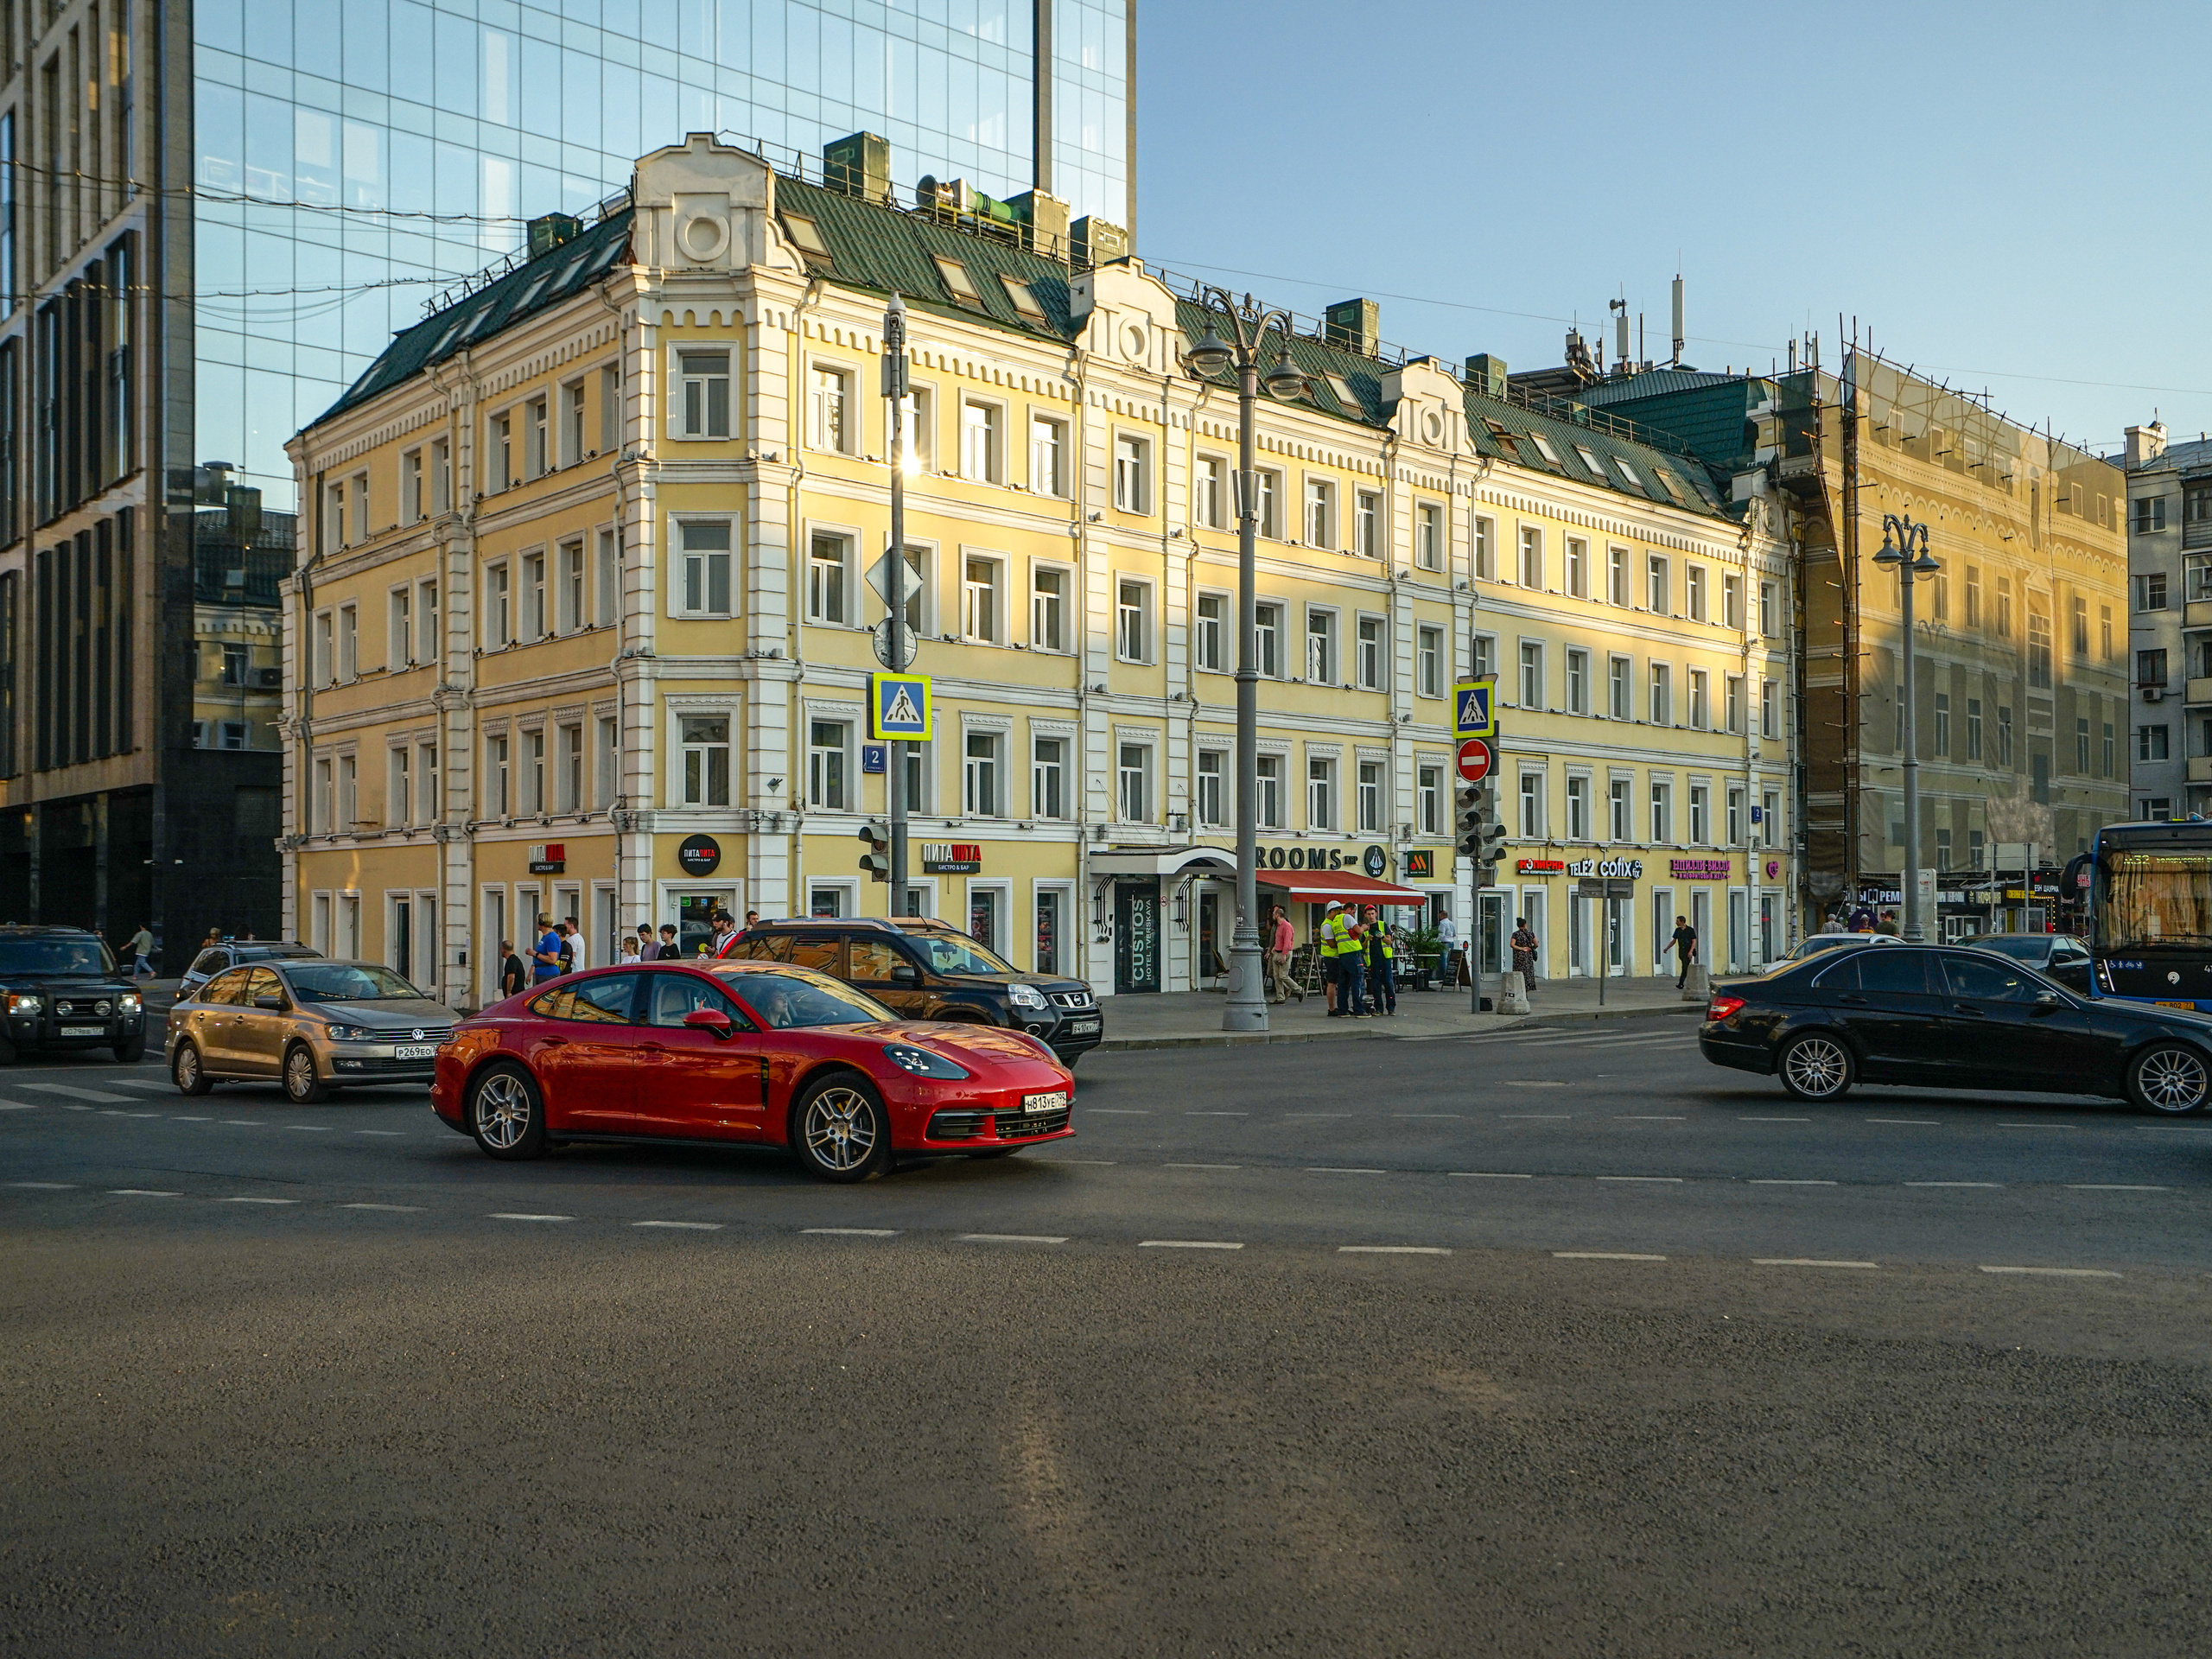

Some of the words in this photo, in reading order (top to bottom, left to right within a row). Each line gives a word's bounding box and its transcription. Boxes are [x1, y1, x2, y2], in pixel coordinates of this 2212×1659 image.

[872, 751, 880, 763] 2
[1756, 809, 1760, 817] 2
[1236, 846, 1343, 870] ROOMS
[1569, 859, 1595, 876] TELE2
[1133, 899, 1144, 981] CUSTOS
